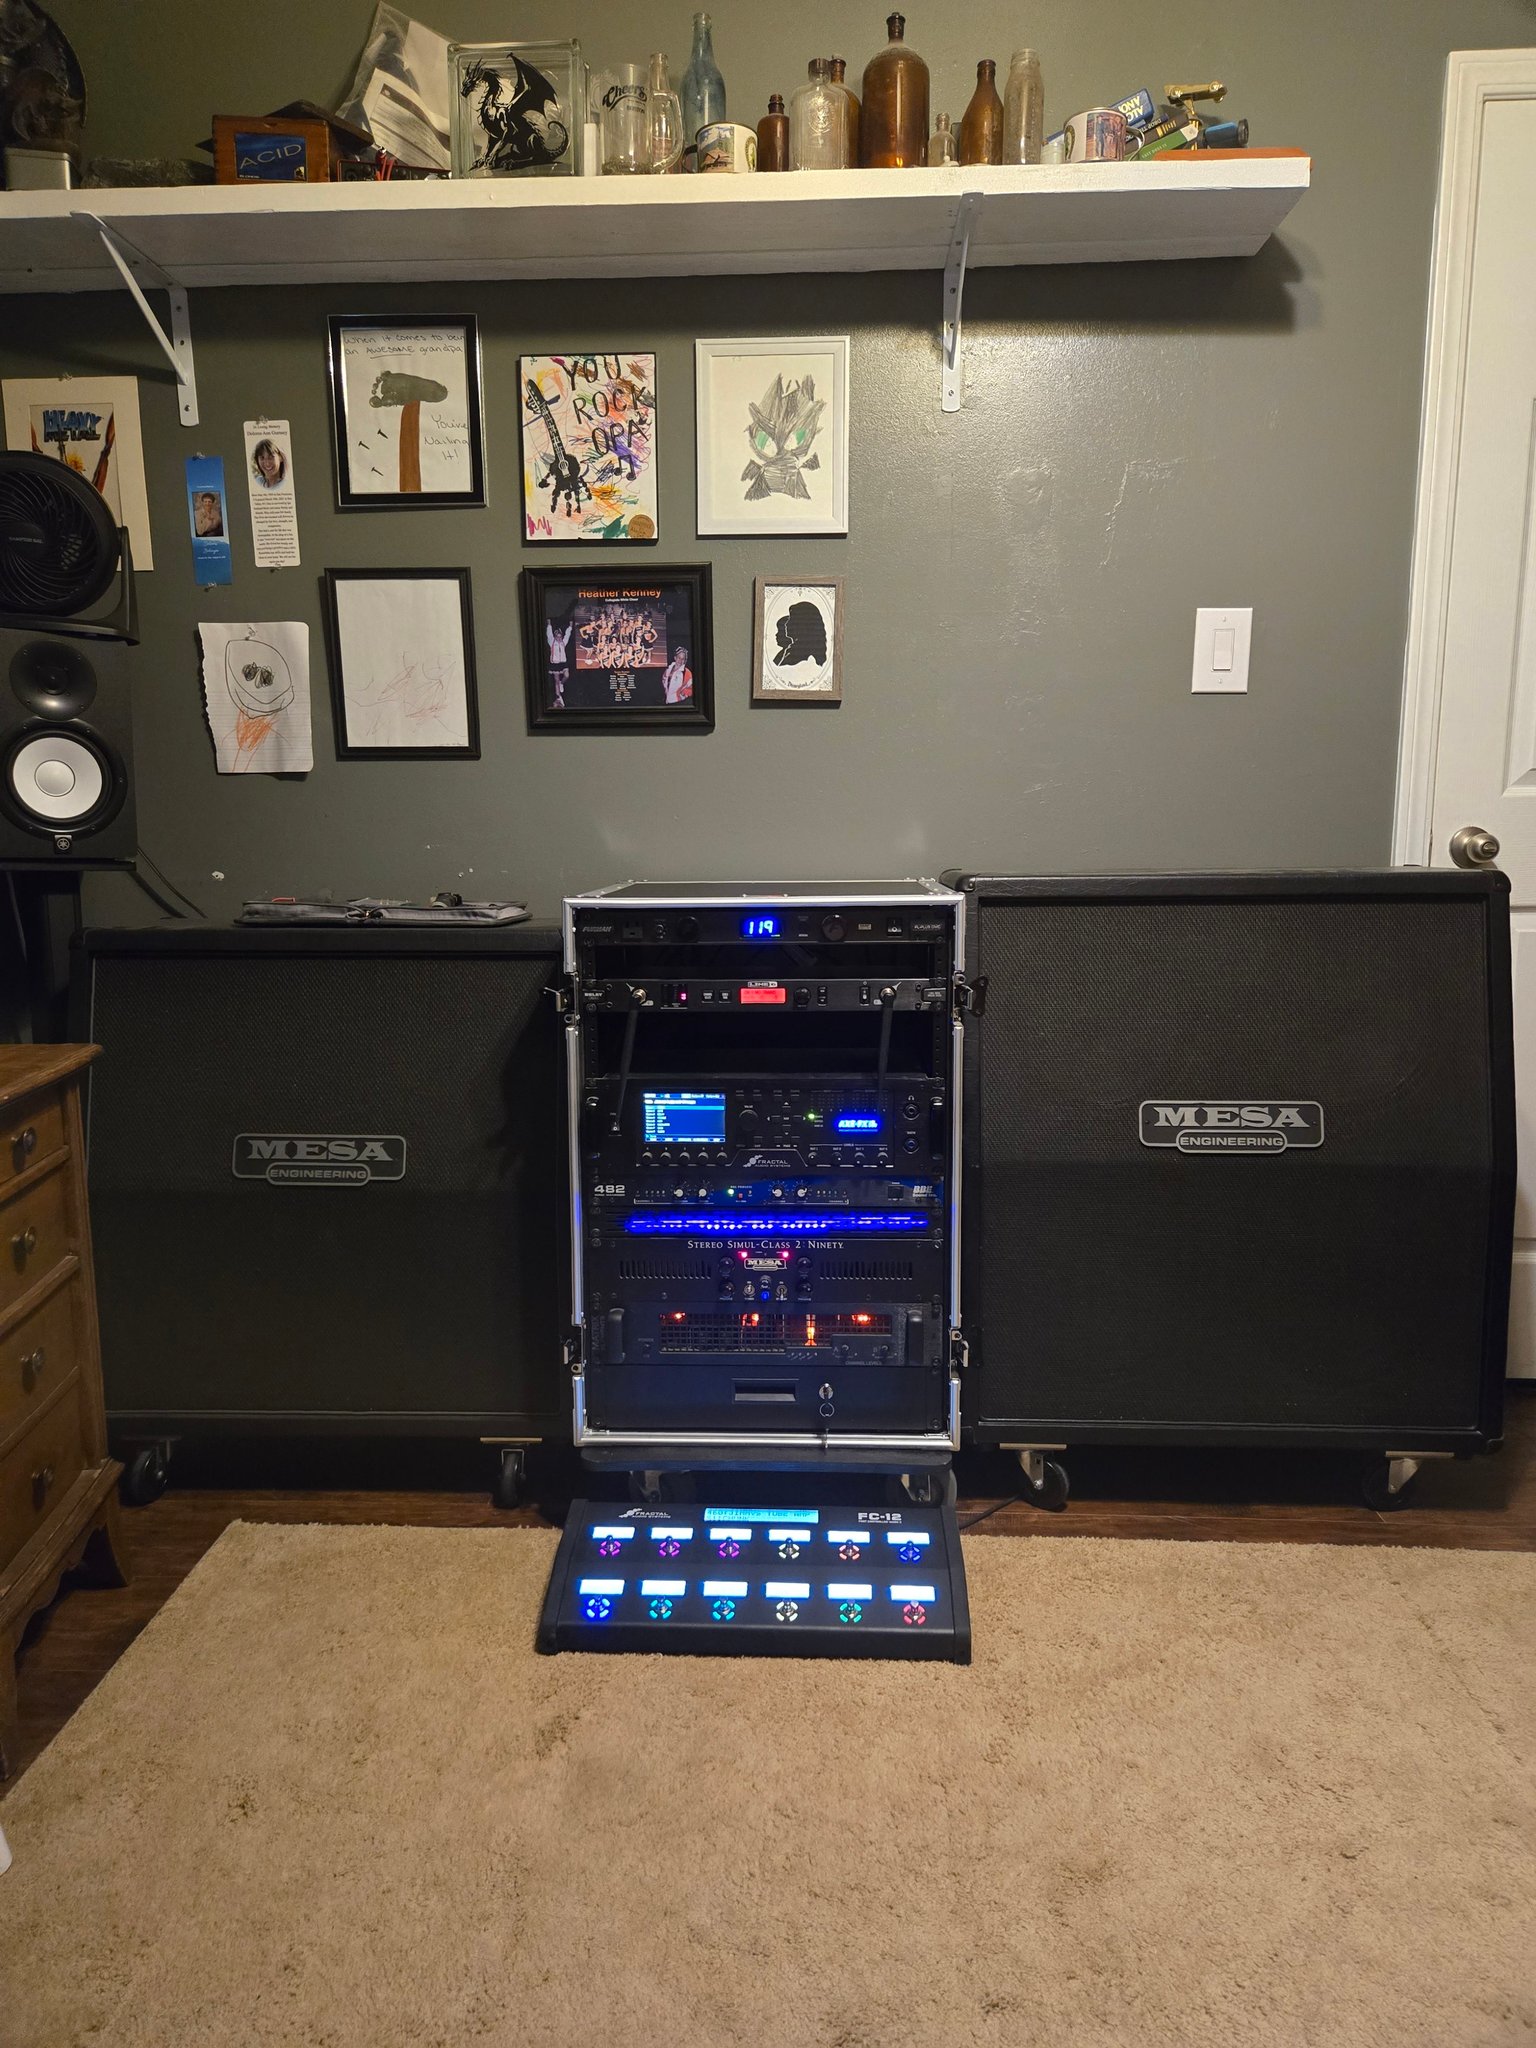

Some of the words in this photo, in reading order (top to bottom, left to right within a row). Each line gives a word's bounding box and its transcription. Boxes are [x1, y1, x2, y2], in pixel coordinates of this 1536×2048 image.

[602, 84, 648, 112] Cheers
[239, 144, 302, 170] ACID
[343, 335, 377, 345] When
[395, 334, 427, 342] comes
[447, 333, 465, 341] bein
[420, 344, 463, 356] grandpa
[560, 355, 622, 391] YOU
[572, 386, 656, 425] ROCK
[592, 419, 649, 455] OPA
[748, 920, 774, 935] 119
[1153, 1106, 1310, 1128] MESA
[247, 1139, 393, 1161] MESA
[1180, 1136, 1284, 1147] ENGINEERING
[270, 1168, 368, 1180] ENGINEERING
[594, 1184, 626, 1194] 482
[857, 1512, 902, 1521] FC-12
